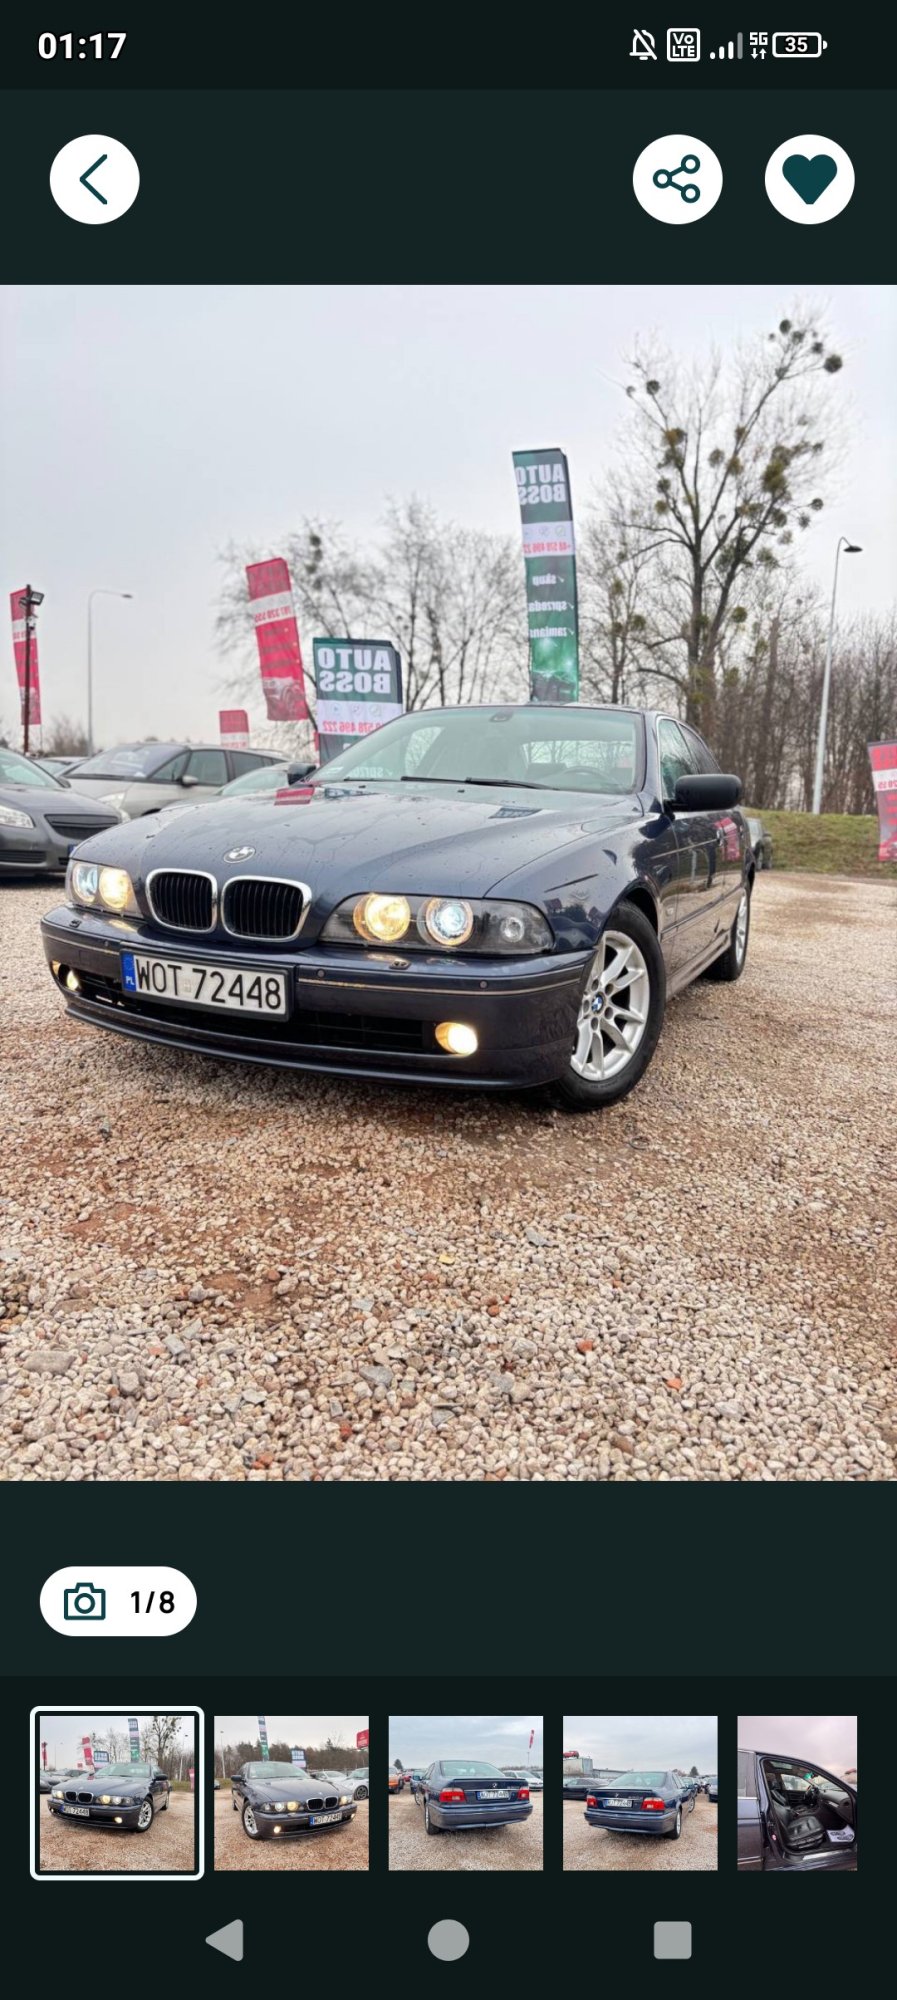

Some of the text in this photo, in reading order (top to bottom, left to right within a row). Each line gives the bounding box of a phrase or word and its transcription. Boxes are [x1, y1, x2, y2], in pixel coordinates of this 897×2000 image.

[38, 32, 127, 59] 01:17
[672, 33, 694, 45] Vo
[749, 32, 768, 45] 5G
[785, 37, 808, 52] 35
[672, 45, 695, 57] LTE
[125, 975, 135, 986] PL
[136, 958, 282, 1010] WOT 72448
[131, 1590, 175, 1614] 1/8
